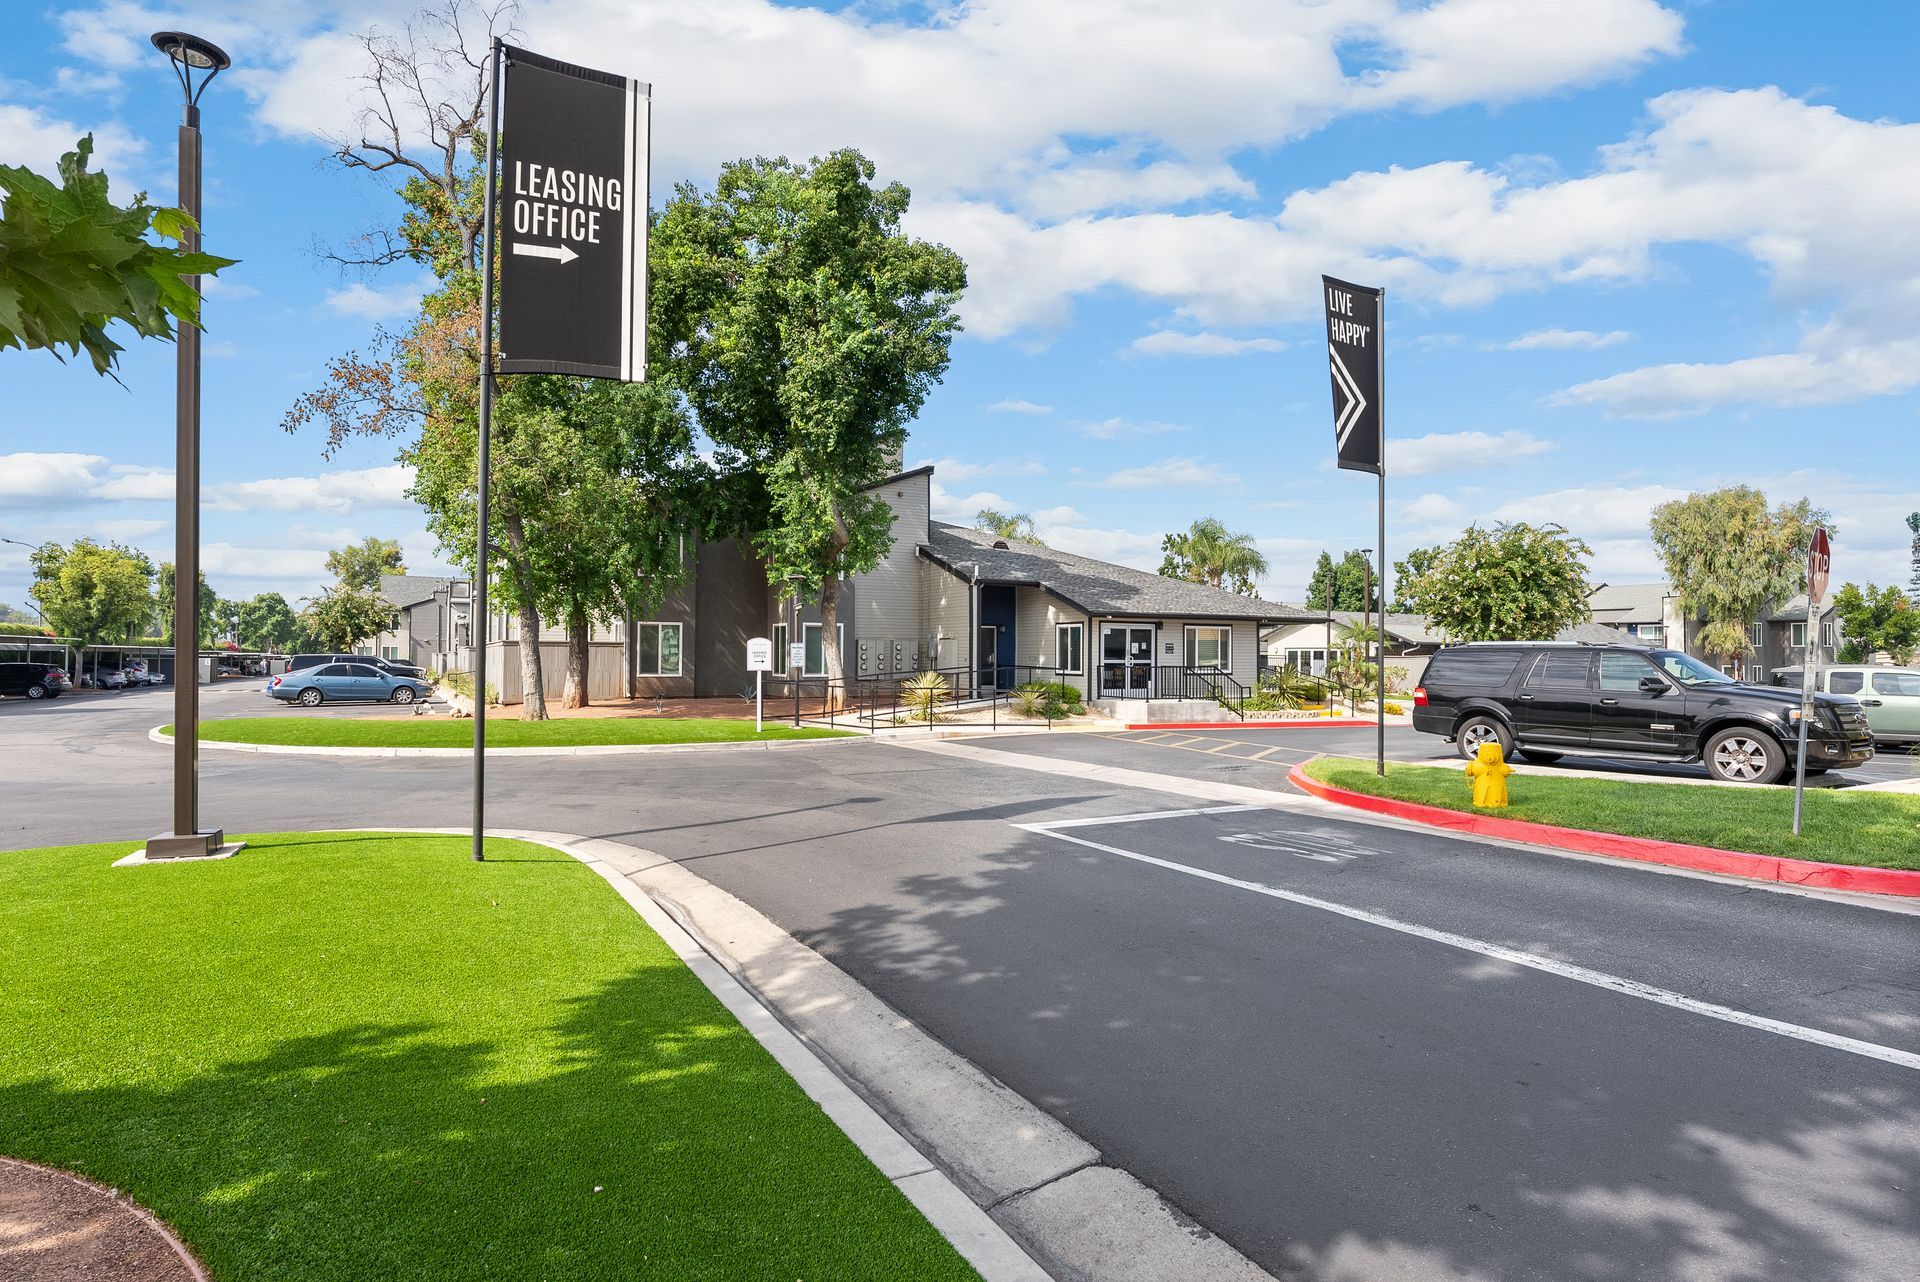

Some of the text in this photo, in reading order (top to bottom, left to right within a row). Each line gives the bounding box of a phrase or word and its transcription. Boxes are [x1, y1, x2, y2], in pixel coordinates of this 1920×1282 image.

[515, 160, 621, 211] LEASING
[513, 199, 600, 244] OFFICE
[1328, 287, 1353, 317] LIVE
[1808, 550, 1829, 581] STOP
